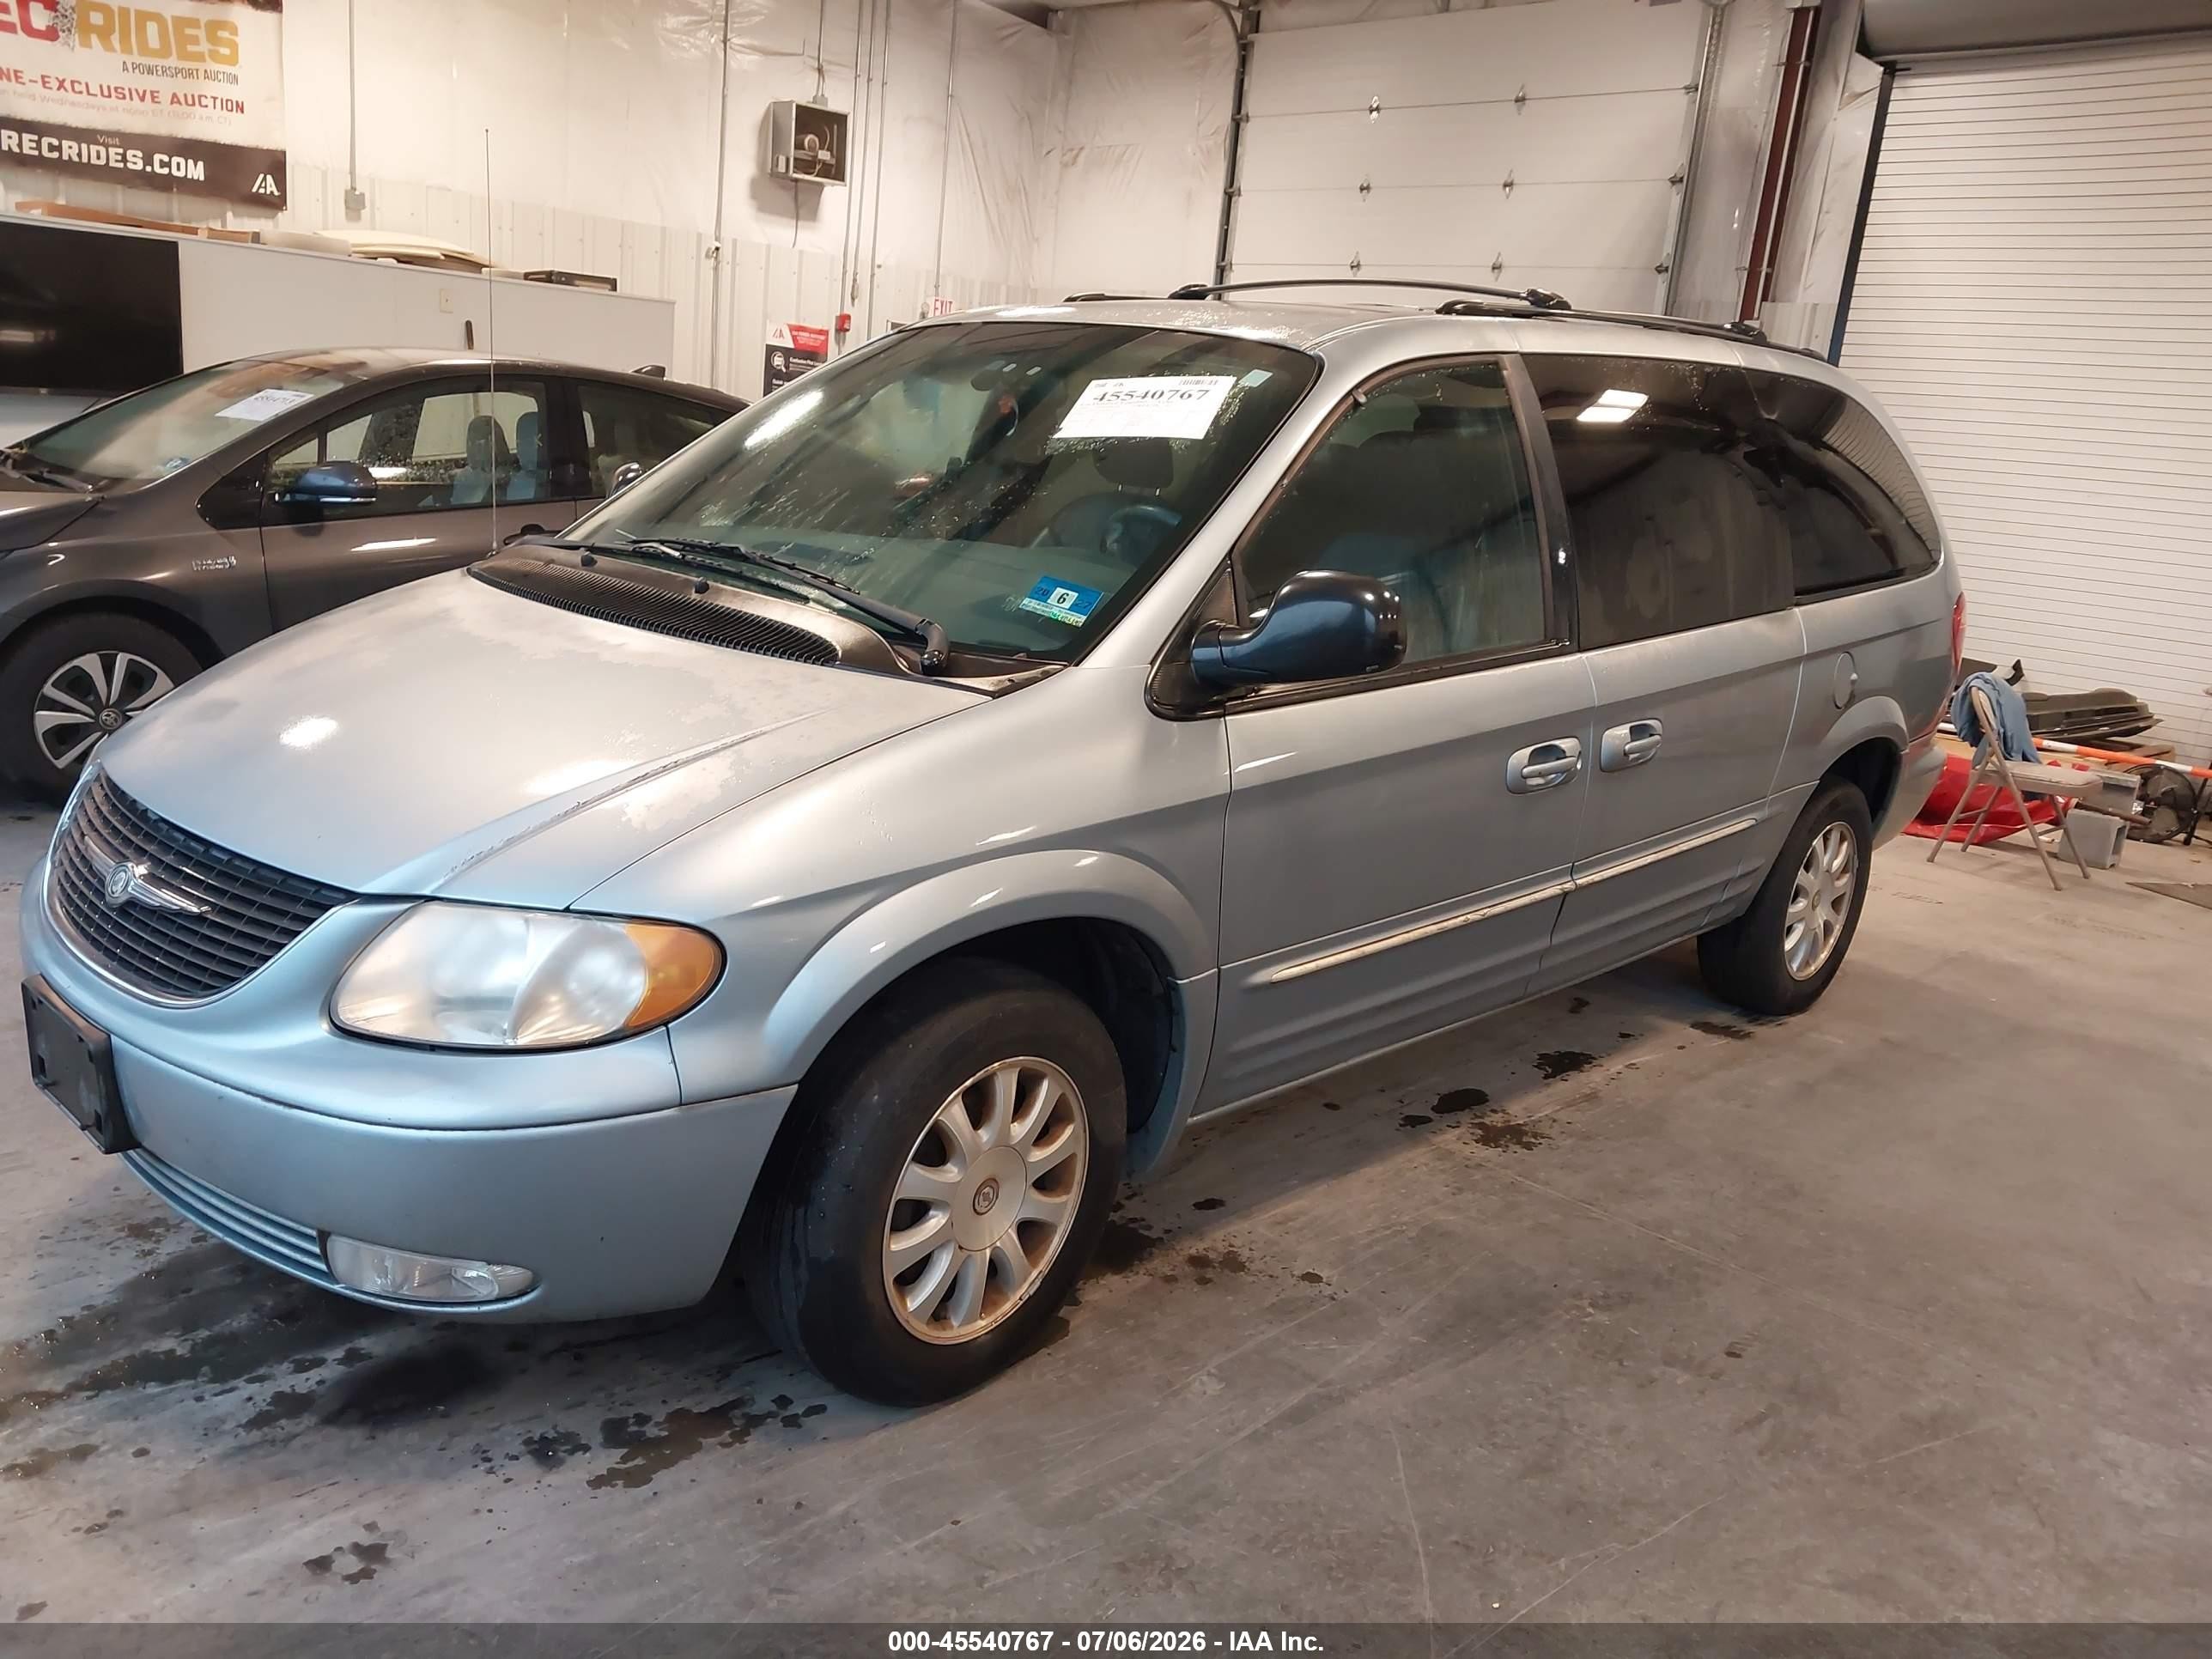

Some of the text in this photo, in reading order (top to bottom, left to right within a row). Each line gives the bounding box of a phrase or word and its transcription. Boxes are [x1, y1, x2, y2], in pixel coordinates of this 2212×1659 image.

[75, 0, 240, 67] RIDES
[122, 60, 239, 86] A POWERSPORT AUCTION
[169, 91, 245, 114] AUCTION
[96, 134, 120, 145] Visit
[1, 129, 205, 181] RECRIDES.COM
[933, 298, 953, 317] EXIT
[1093, 388, 1210, 402] 45540767
[1057, 592, 1069, 605] 6
